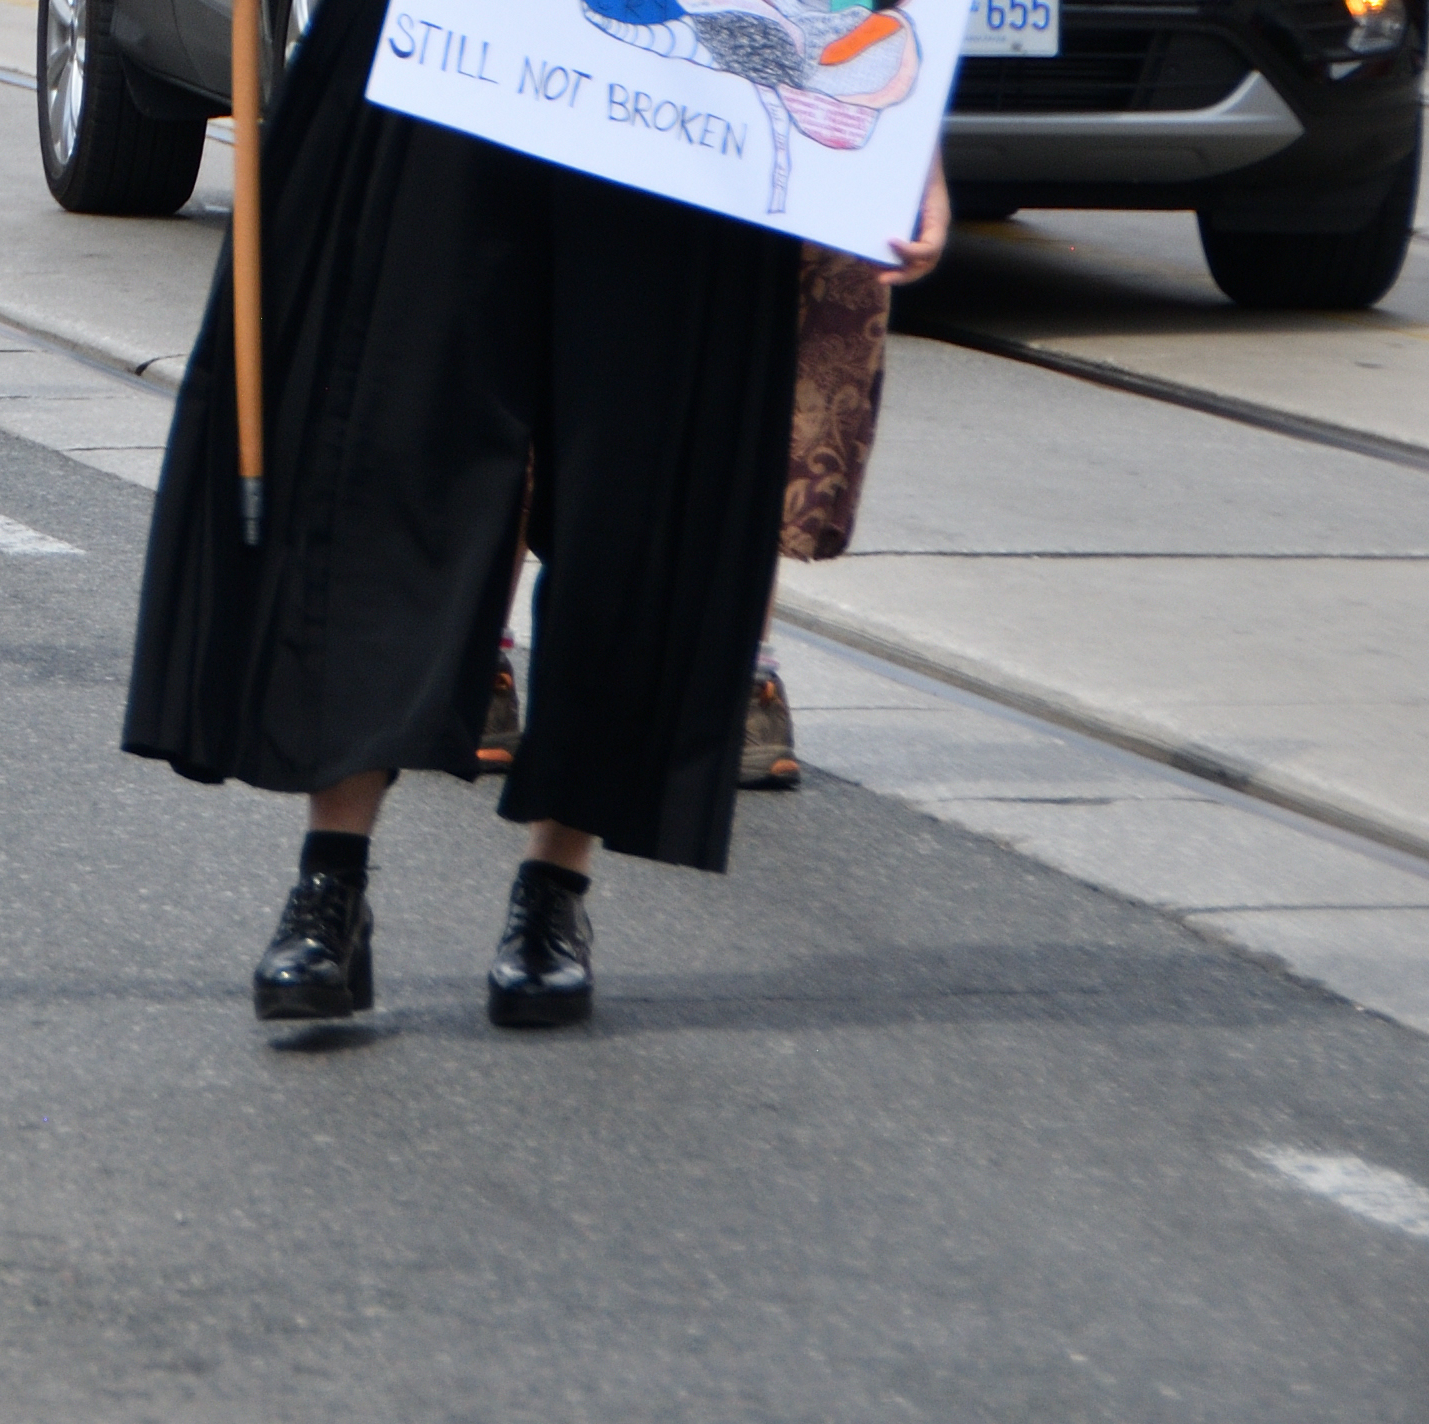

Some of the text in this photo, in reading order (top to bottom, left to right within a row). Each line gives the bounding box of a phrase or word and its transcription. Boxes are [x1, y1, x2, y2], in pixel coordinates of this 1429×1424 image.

[389, 13, 499, 85] STILL
[517, 55, 594, 108] NOT
[607, 83, 748, 160] BROKEN
